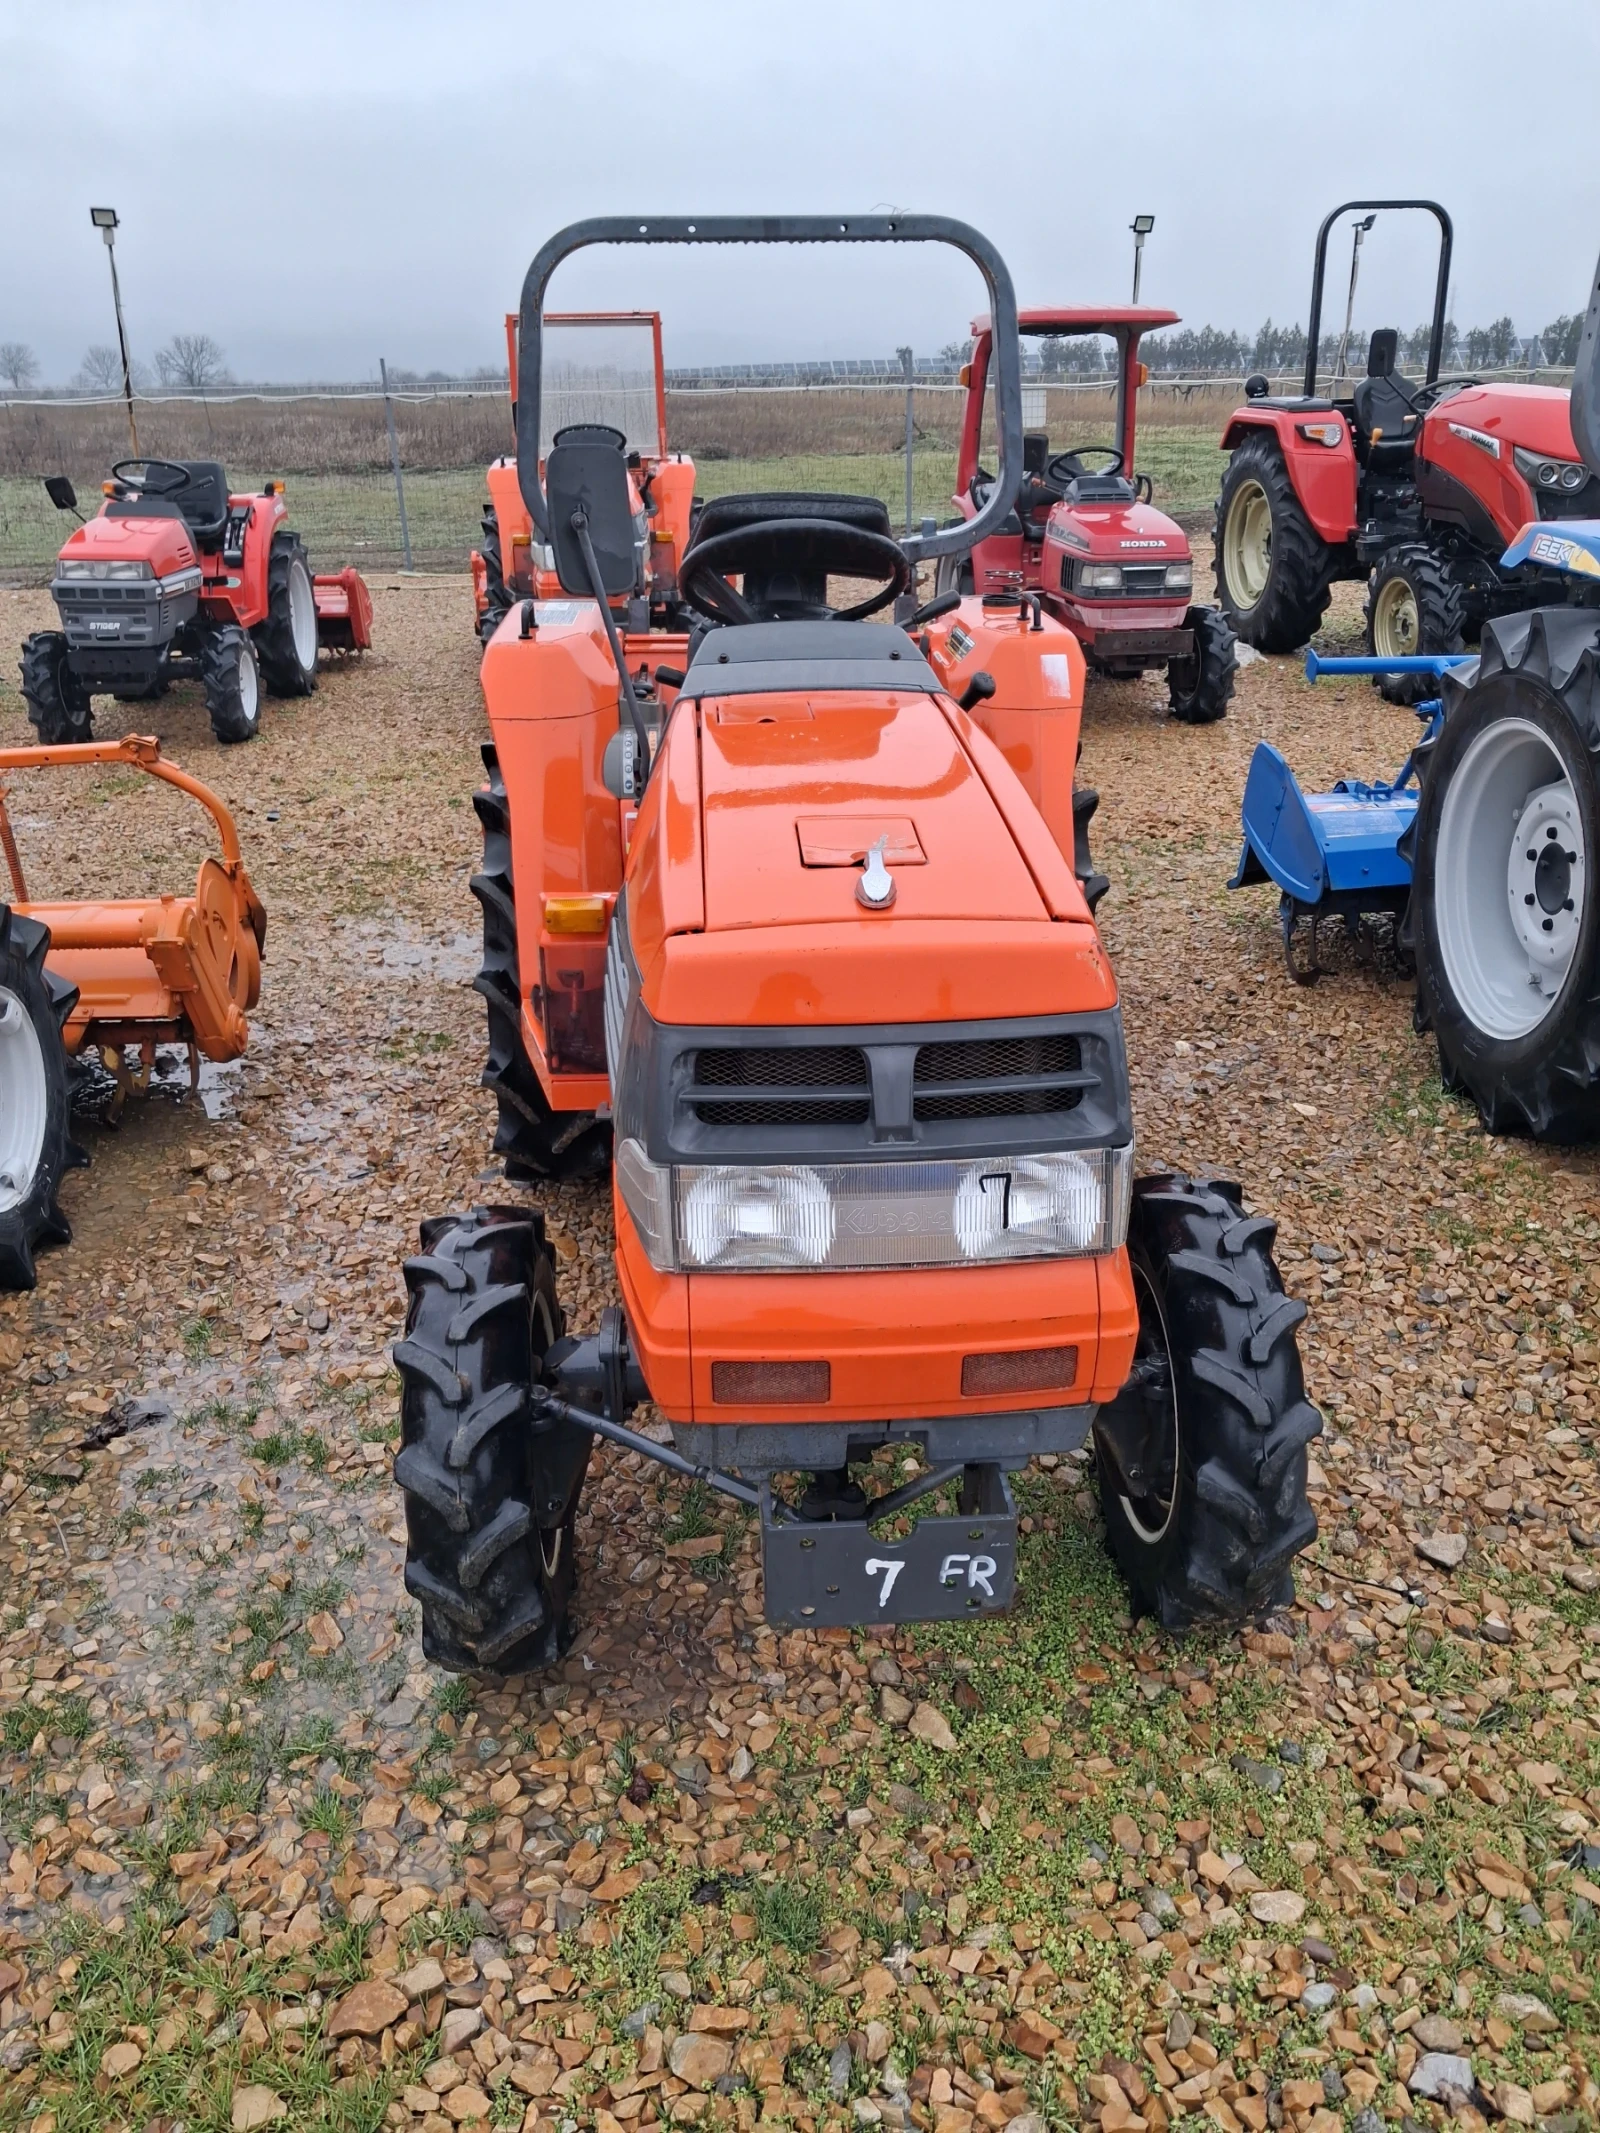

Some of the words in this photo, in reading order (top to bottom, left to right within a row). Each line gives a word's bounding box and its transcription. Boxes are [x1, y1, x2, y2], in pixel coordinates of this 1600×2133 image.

[1120, 540, 1167, 548] HONDA
[837, 1205, 953, 1235] Kubota
[978, 1172, 1012, 1229] 7
[865, 1558, 906, 1607] 7
[939, 1554, 997, 1597] FR
